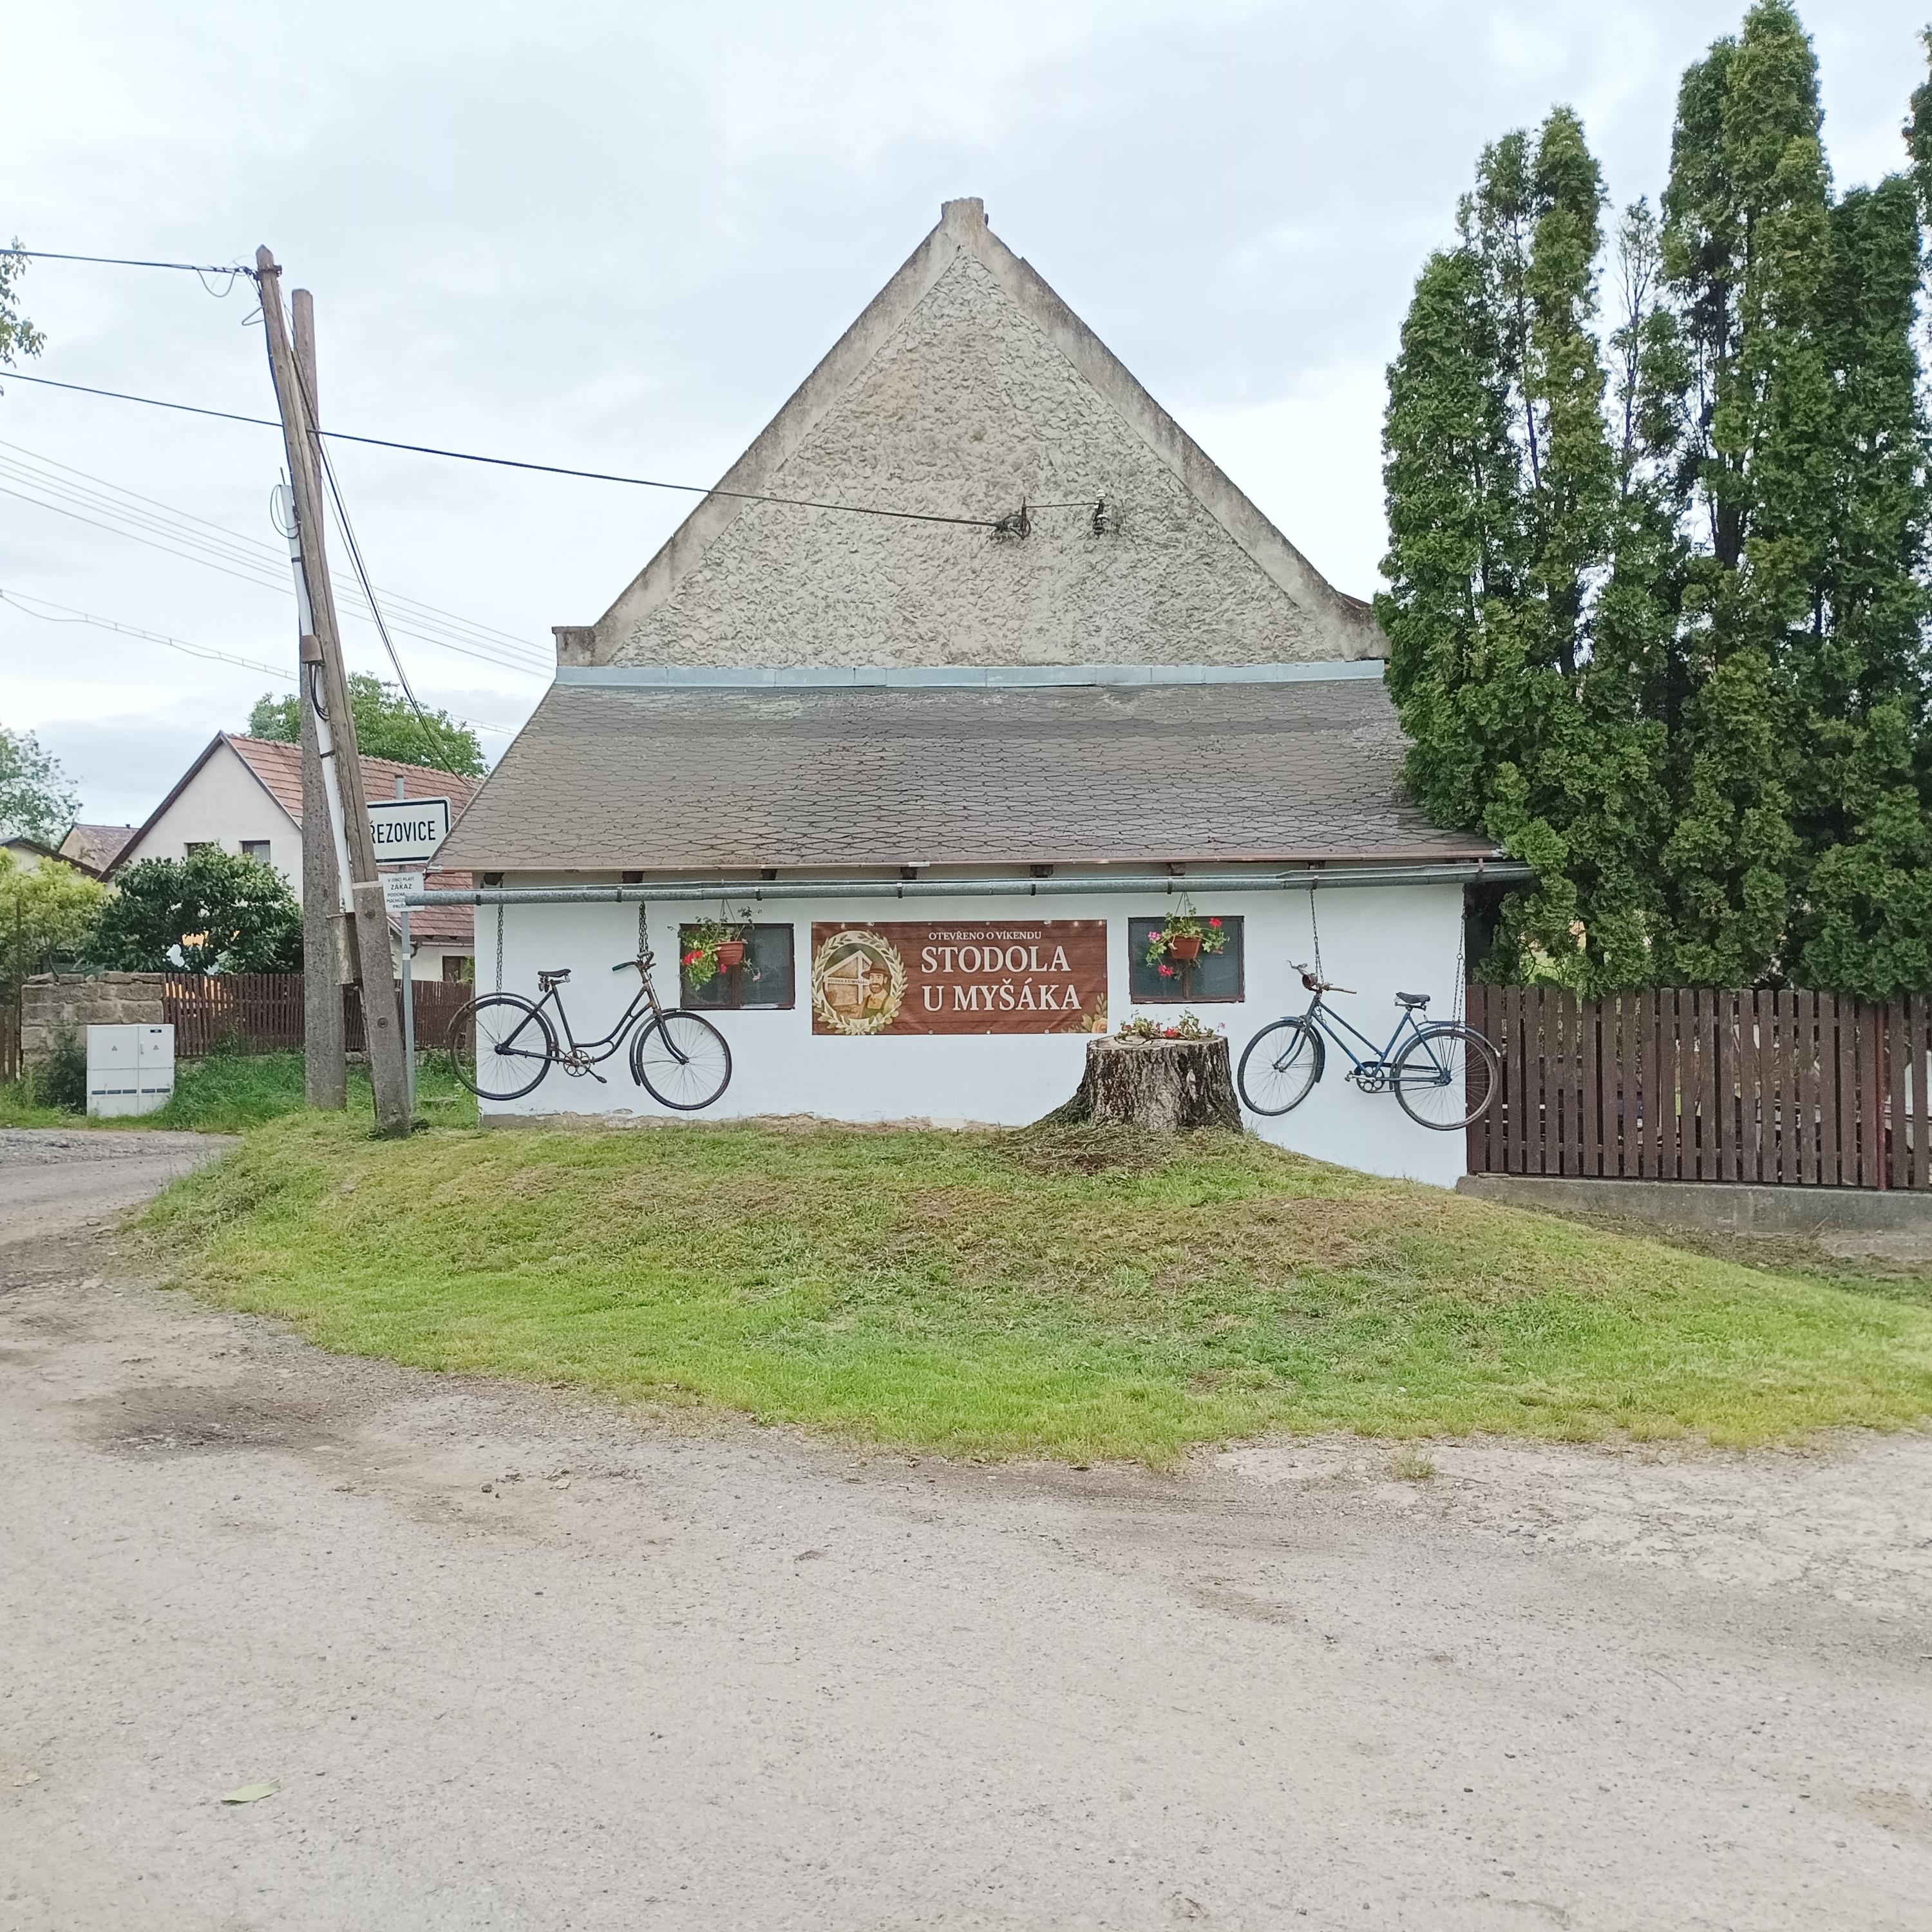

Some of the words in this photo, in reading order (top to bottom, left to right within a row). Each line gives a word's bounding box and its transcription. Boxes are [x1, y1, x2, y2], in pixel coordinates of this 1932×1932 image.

[369, 820, 436, 844] ŘEZOVICE
[929, 931, 985, 940] OTEVŘENO
[986, 932, 994, 940] O
[996, 931, 1042, 940] VÍKENDU
[921, 945, 1072, 973] STODOLA
[922, 985, 944, 1011] U
[952, 977, 1082, 1011] MYŠÁKA
